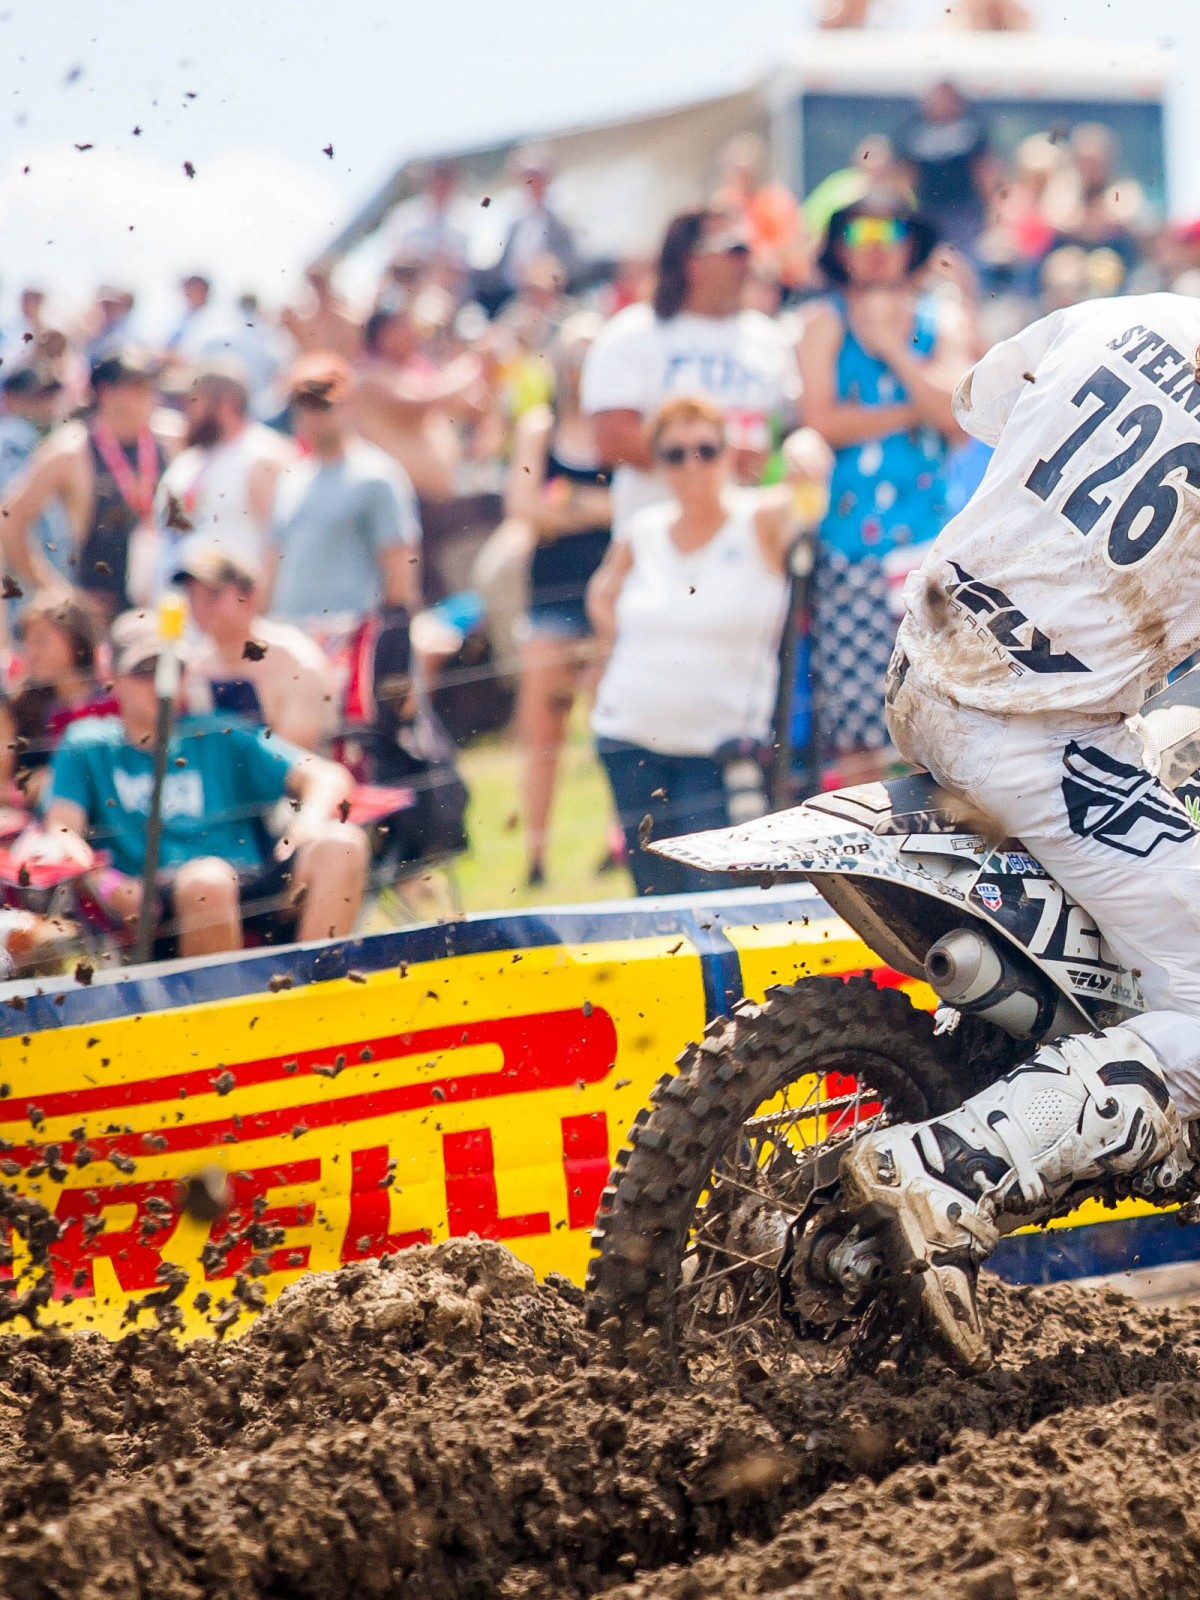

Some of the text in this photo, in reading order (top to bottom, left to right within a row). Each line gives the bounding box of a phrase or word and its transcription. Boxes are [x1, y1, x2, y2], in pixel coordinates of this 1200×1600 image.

[946, 560, 1093, 674] FLY
[949, 601, 1026, 678] RACING
[791, 843, 870, 862] DUNLOP
[1066, 969, 1112, 990] FLY
